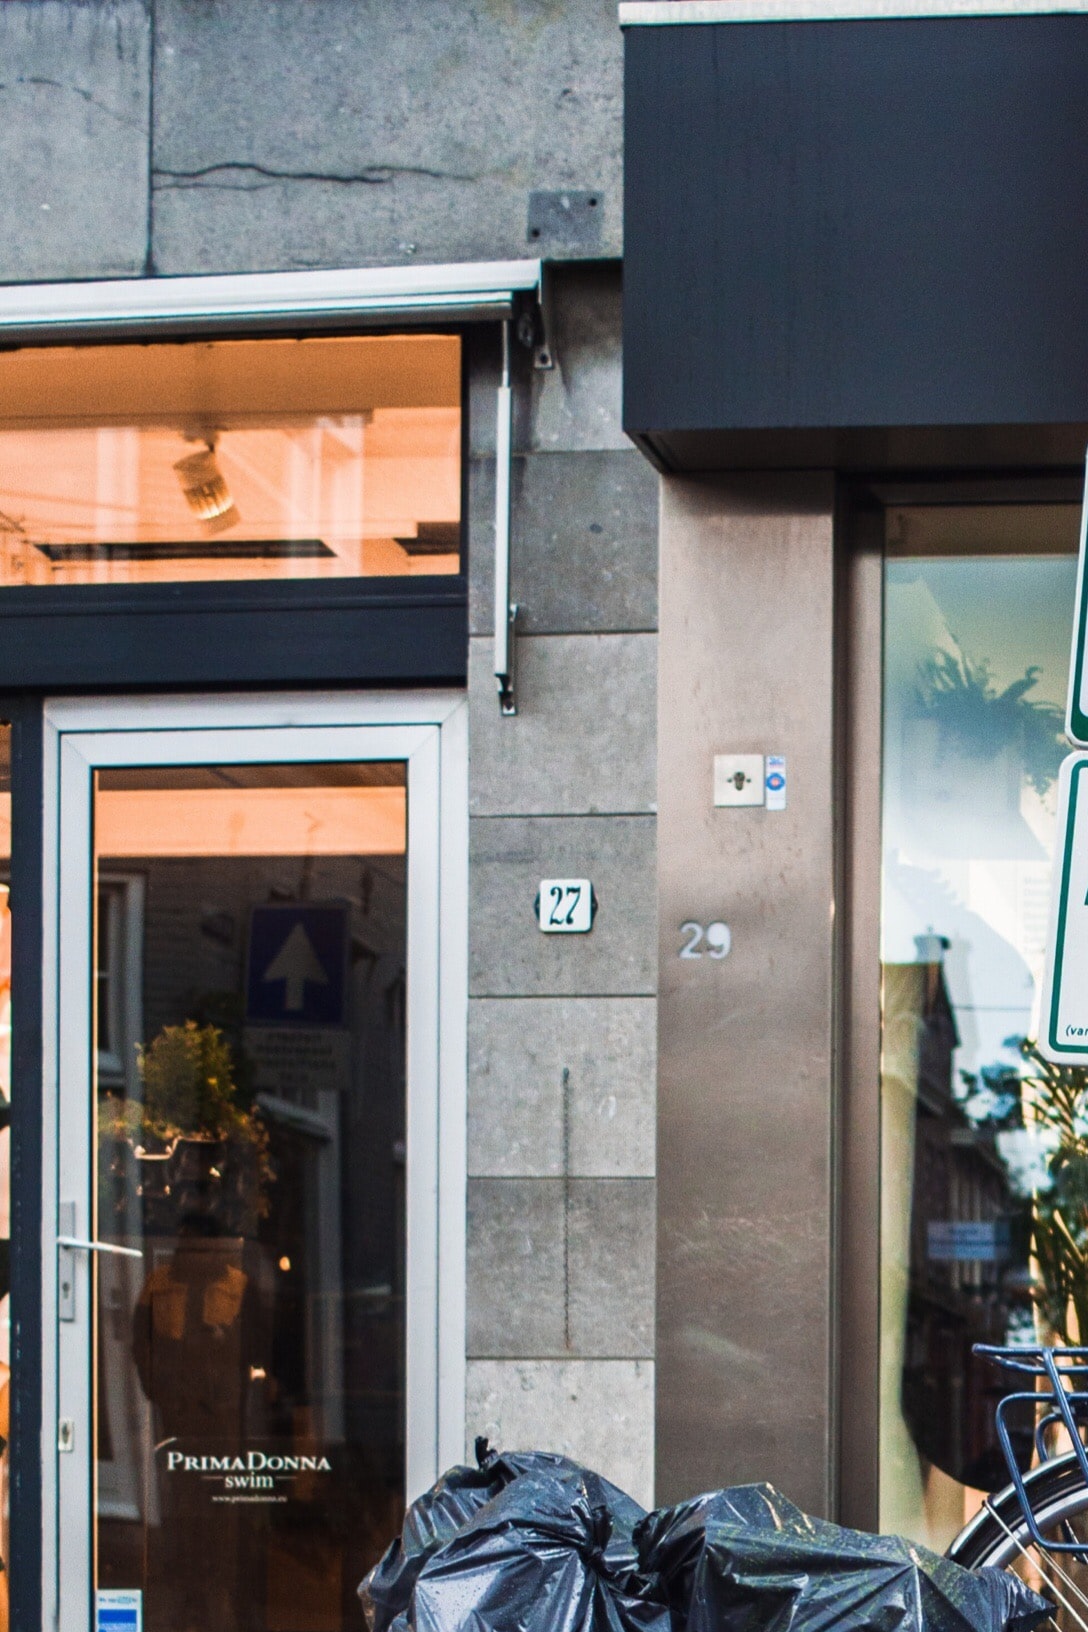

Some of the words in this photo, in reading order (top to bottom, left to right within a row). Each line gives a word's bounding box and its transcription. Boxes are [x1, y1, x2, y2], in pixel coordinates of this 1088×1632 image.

[549, 886, 582, 925] 27
[678, 921, 732, 959] 29
[224, 1471, 274, 1489] swim
